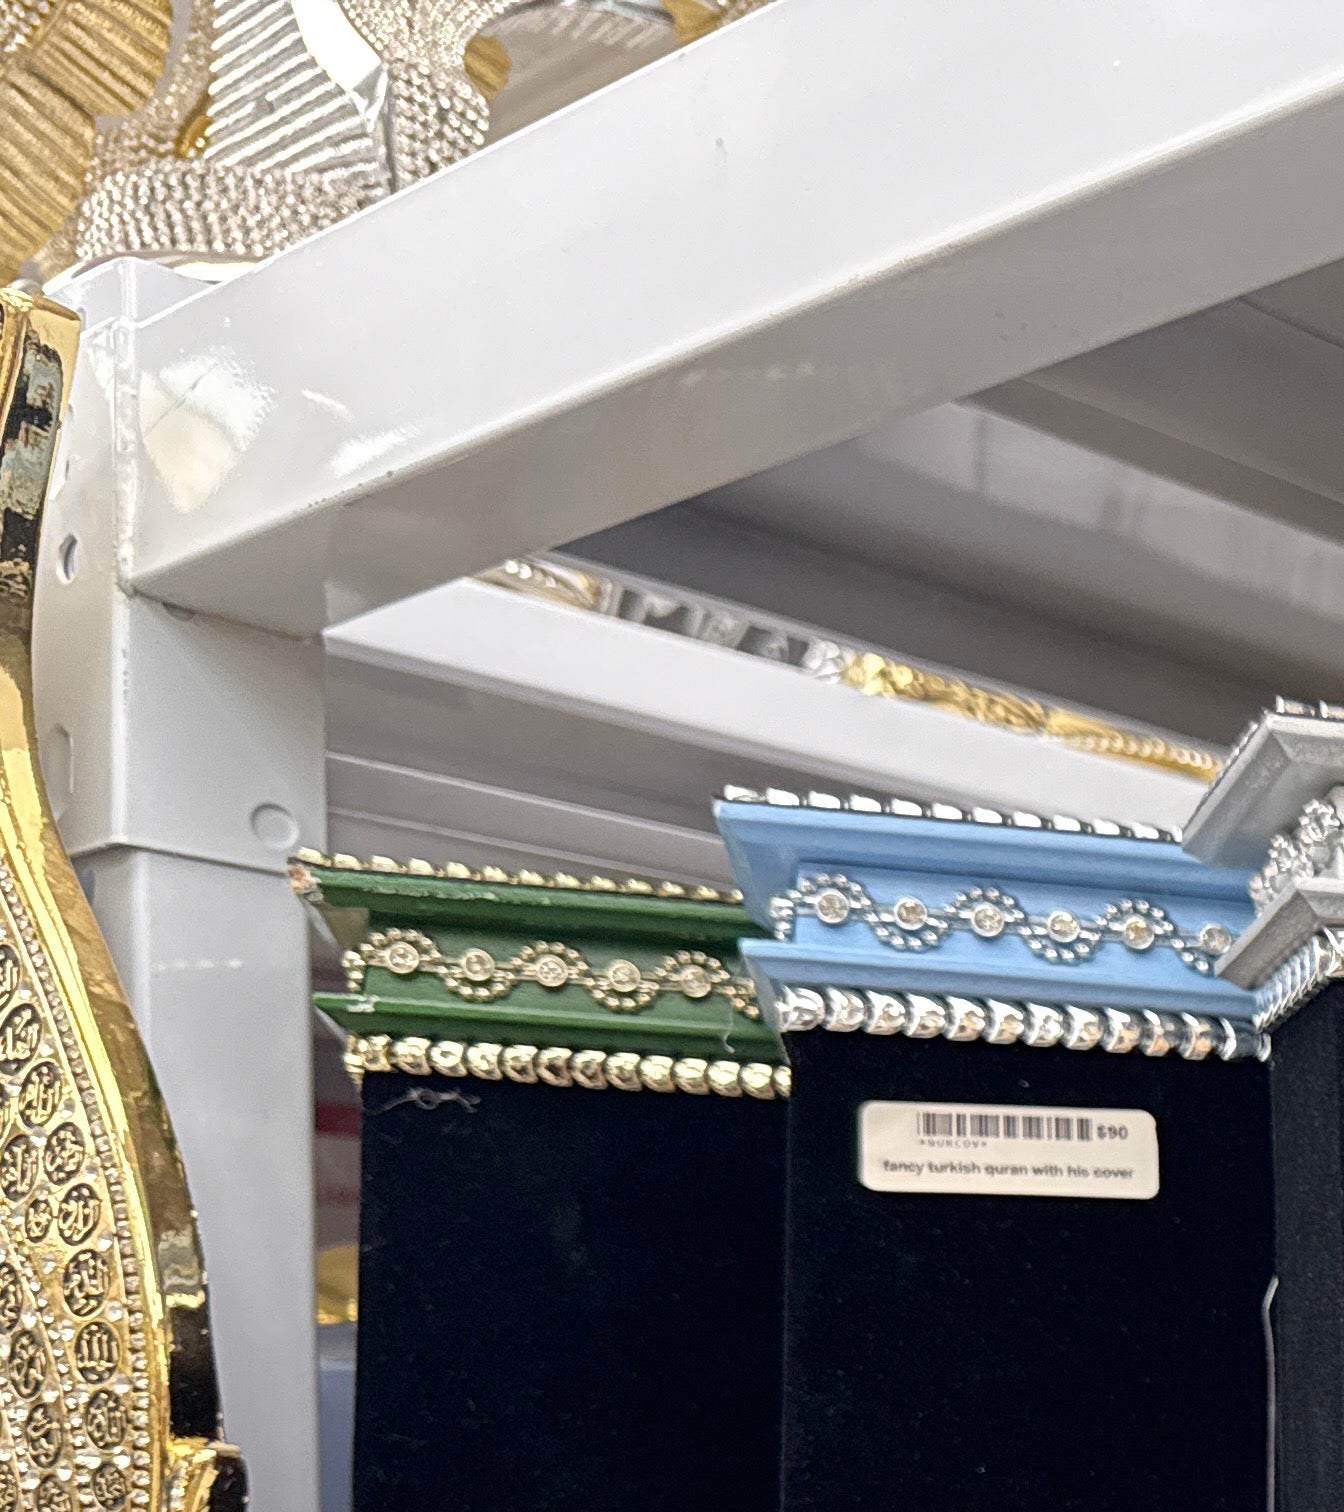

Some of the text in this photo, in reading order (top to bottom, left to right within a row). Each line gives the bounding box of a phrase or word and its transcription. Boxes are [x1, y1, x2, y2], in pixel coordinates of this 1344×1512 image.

[1096, 1123, 1129, 1141] $90
[882, 1159, 1136, 1180] fancy turkish quran with his cover
